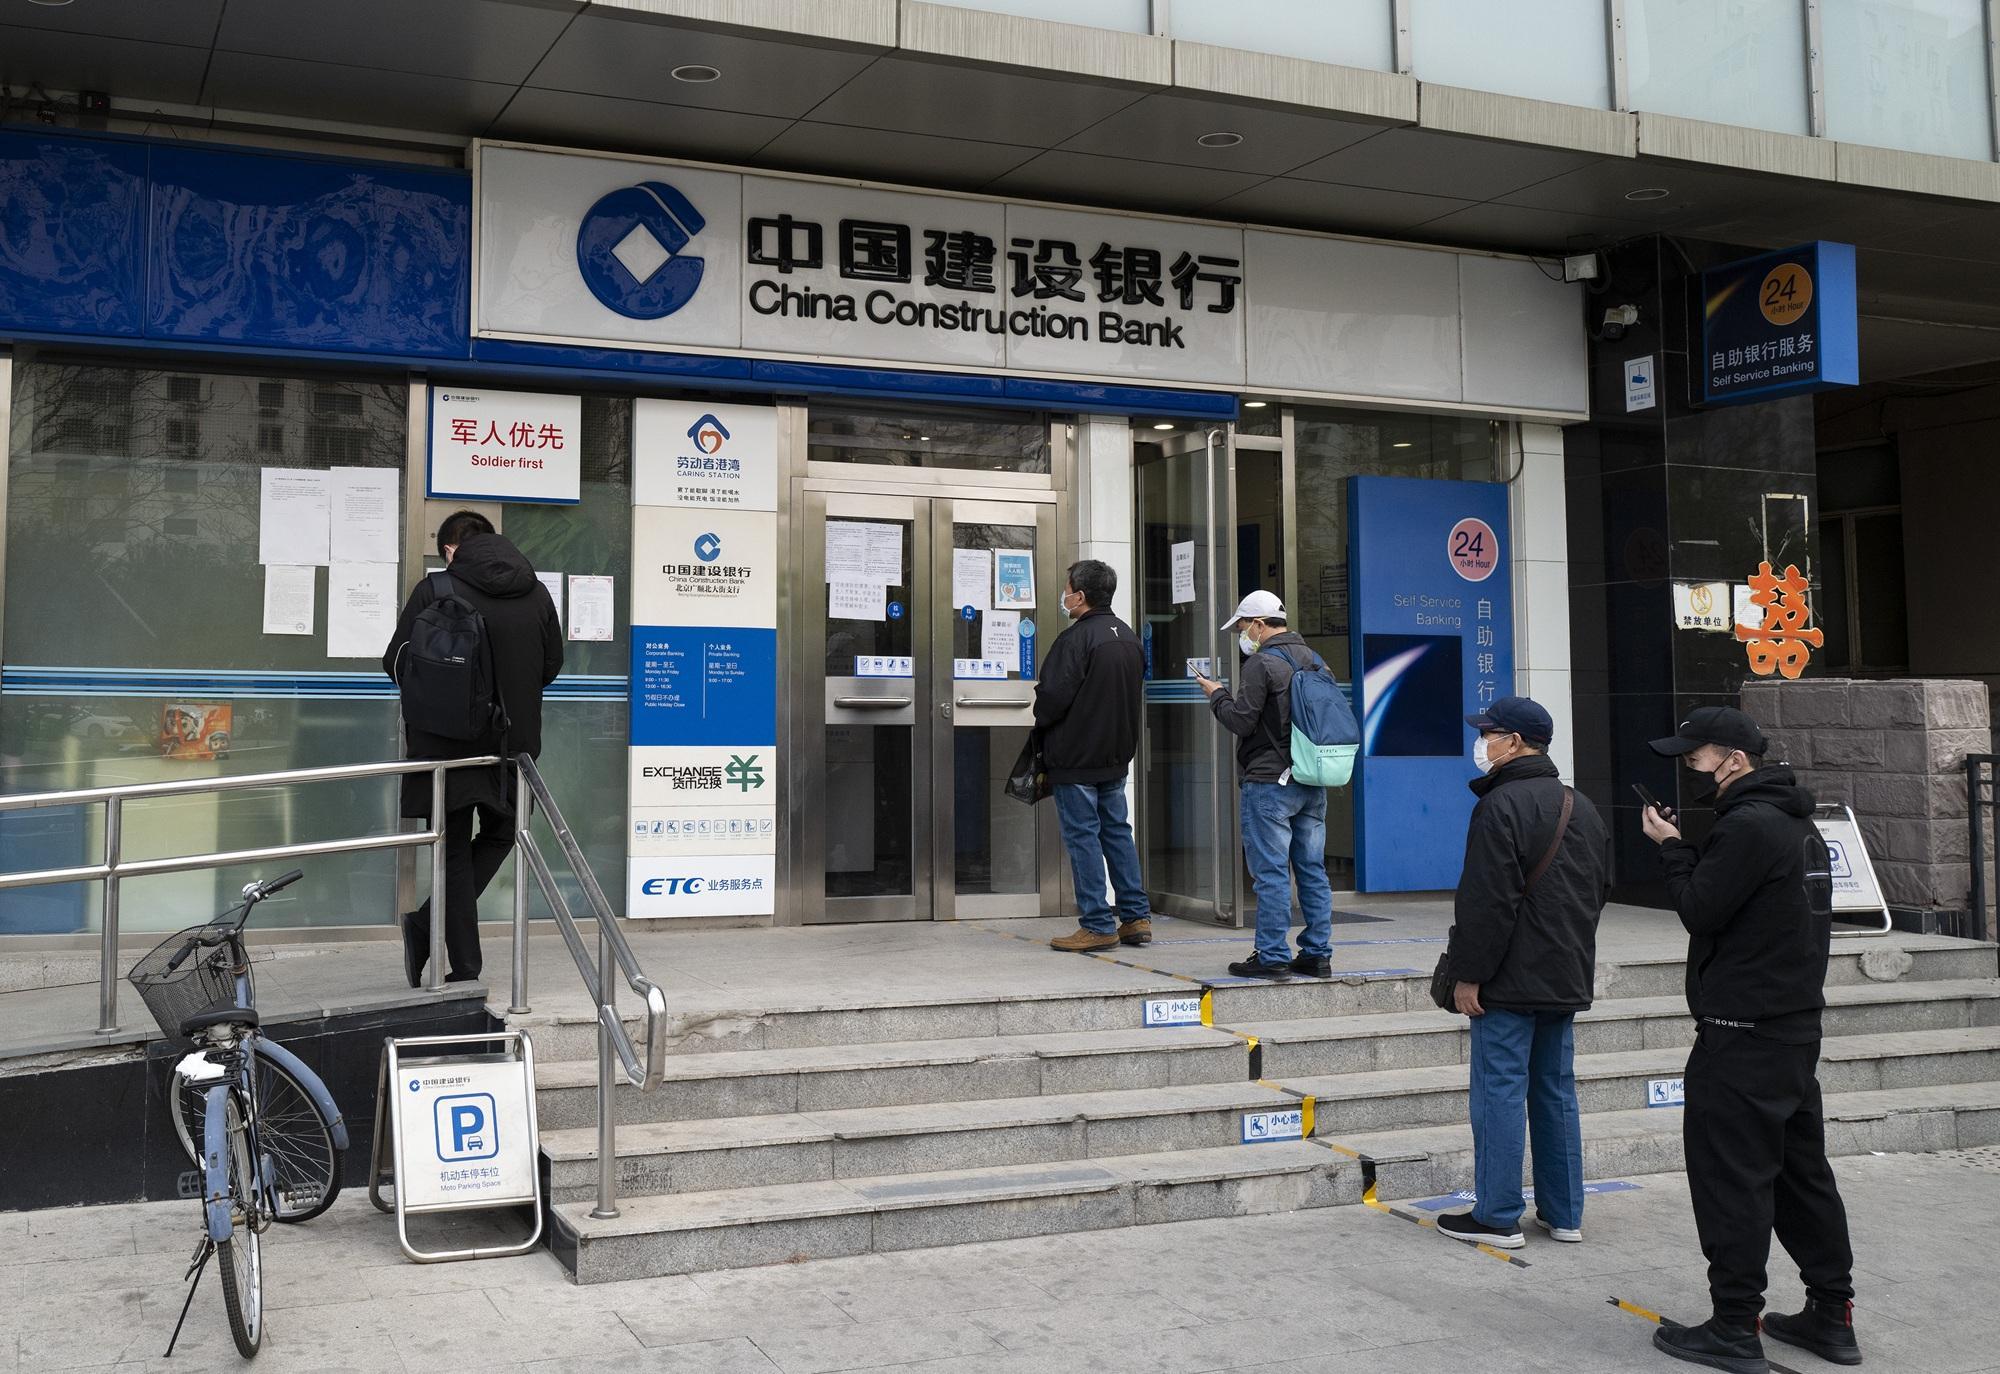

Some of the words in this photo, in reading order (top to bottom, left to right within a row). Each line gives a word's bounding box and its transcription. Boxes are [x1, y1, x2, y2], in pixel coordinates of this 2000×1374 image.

[748, 214, 1242, 313] 中国建设银行
[1765, 274, 1796, 306] 24
[1787, 302, 1804, 311] Hour
[750, 280, 857, 321] China
[865, 289, 1089, 342] Construction
[1099, 311, 1185, 349] Bank
[1712, 333, 1813, 371] 自助银行服务
[1712, 375, 1731, 387] Self
[1733, 369, 1770, 384] Service
[1772, 361, 1814, 377] Banking
[451, 419, 564, 450] 军人优先
[471, 455, 515, 468] Soldier
[518, 457, 543, 469] first
[677, 456, 741, 471] 劳动者港湾
[677, 470, 706, 478] CARING
[1454, 531, 1484, 557] 24
[1460, 559, 1474, 568] 小时
[1475, 560, 1491, 568] Hour
[662, 564, 752, 578] 中国建设银行
[668, 575, 688, 583] China
[688, 576, 728, 585] Construction
[1394, 594, 1416, 607] Self
[1420, 595, 1462, 609] Service
[1416, 612, 1461, 629] Banking
[1683, 616, 1722, 627] 禁放单位
[708, 643, 732, 651] 个人业务
[645, 661, 675, 669] 星期一至五
[708, 662, 738, 670] 星期一至日
[643, 766, 722, 777] EXCHANGE
[672, 777, 722, 789] 货币兑换
[641, 877, 705, 895] ETC
[708, 878, 763, 891] 业务服务点
[1715, 1018, 1739, 1028] HOME
[422, 1077, 471, 1085] 中国建设银行
[451, 1104, 484, 1152] P
[440, 1166, 500, 1181] 机动车停车位
[457, 1182, 481, 1190] Parking
[482, 1180, 501, 1188] Space
